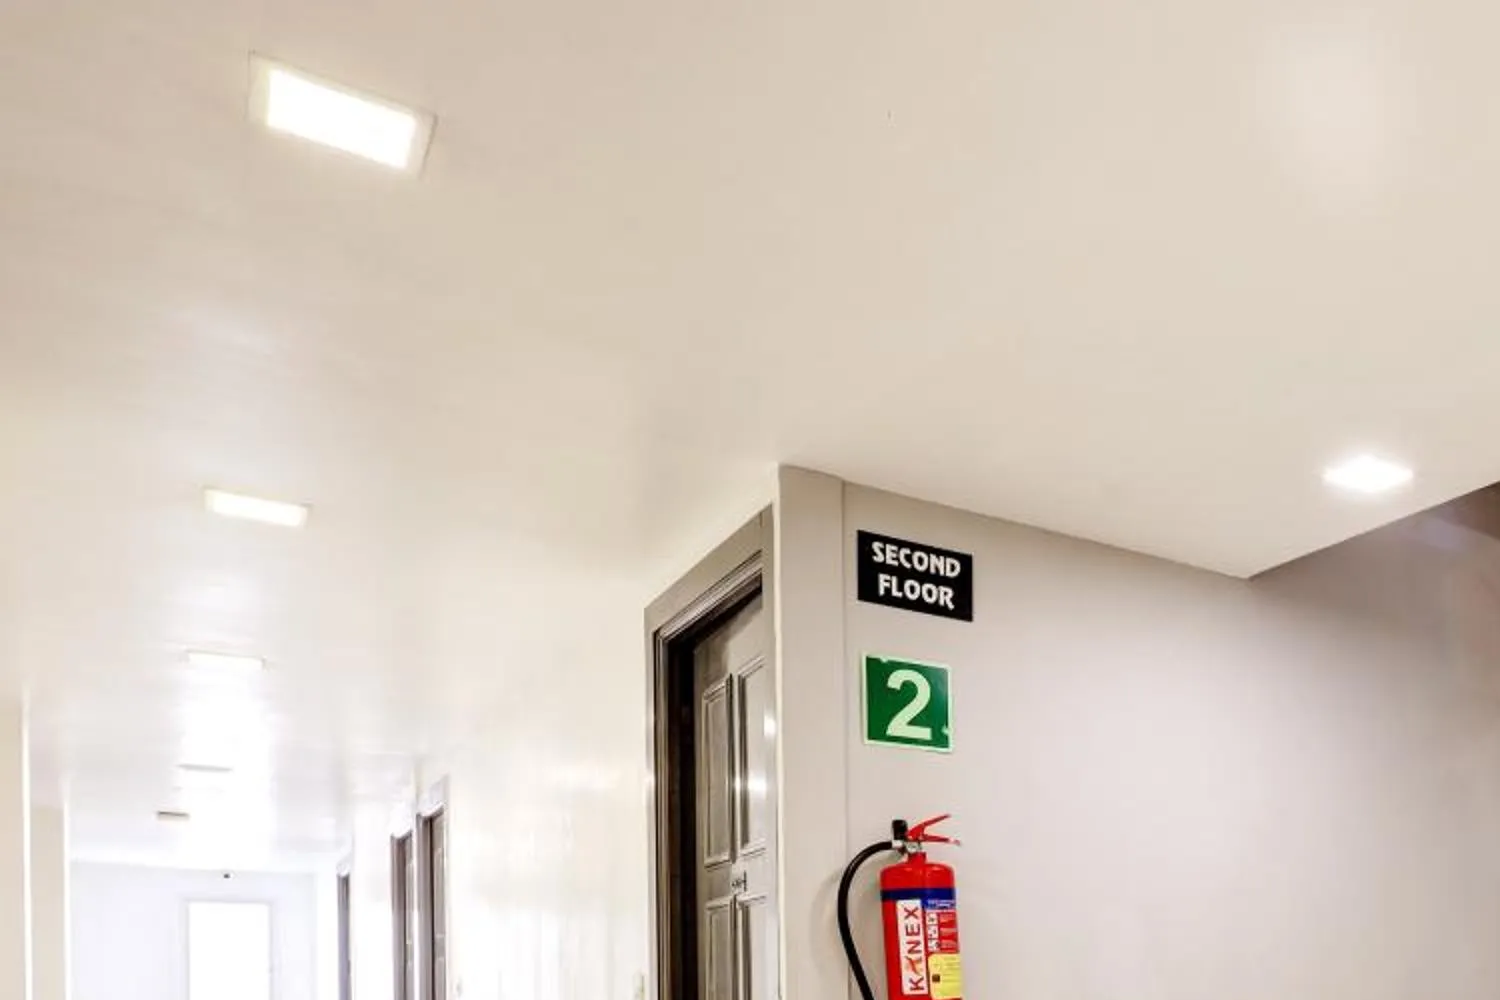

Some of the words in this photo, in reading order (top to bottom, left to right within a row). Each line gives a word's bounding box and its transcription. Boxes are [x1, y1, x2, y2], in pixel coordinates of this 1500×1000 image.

[871, 541, 961, 578] SECOND
[877, 573, 955, 610] FLOOR
[885, 669, 932, 741] 2
